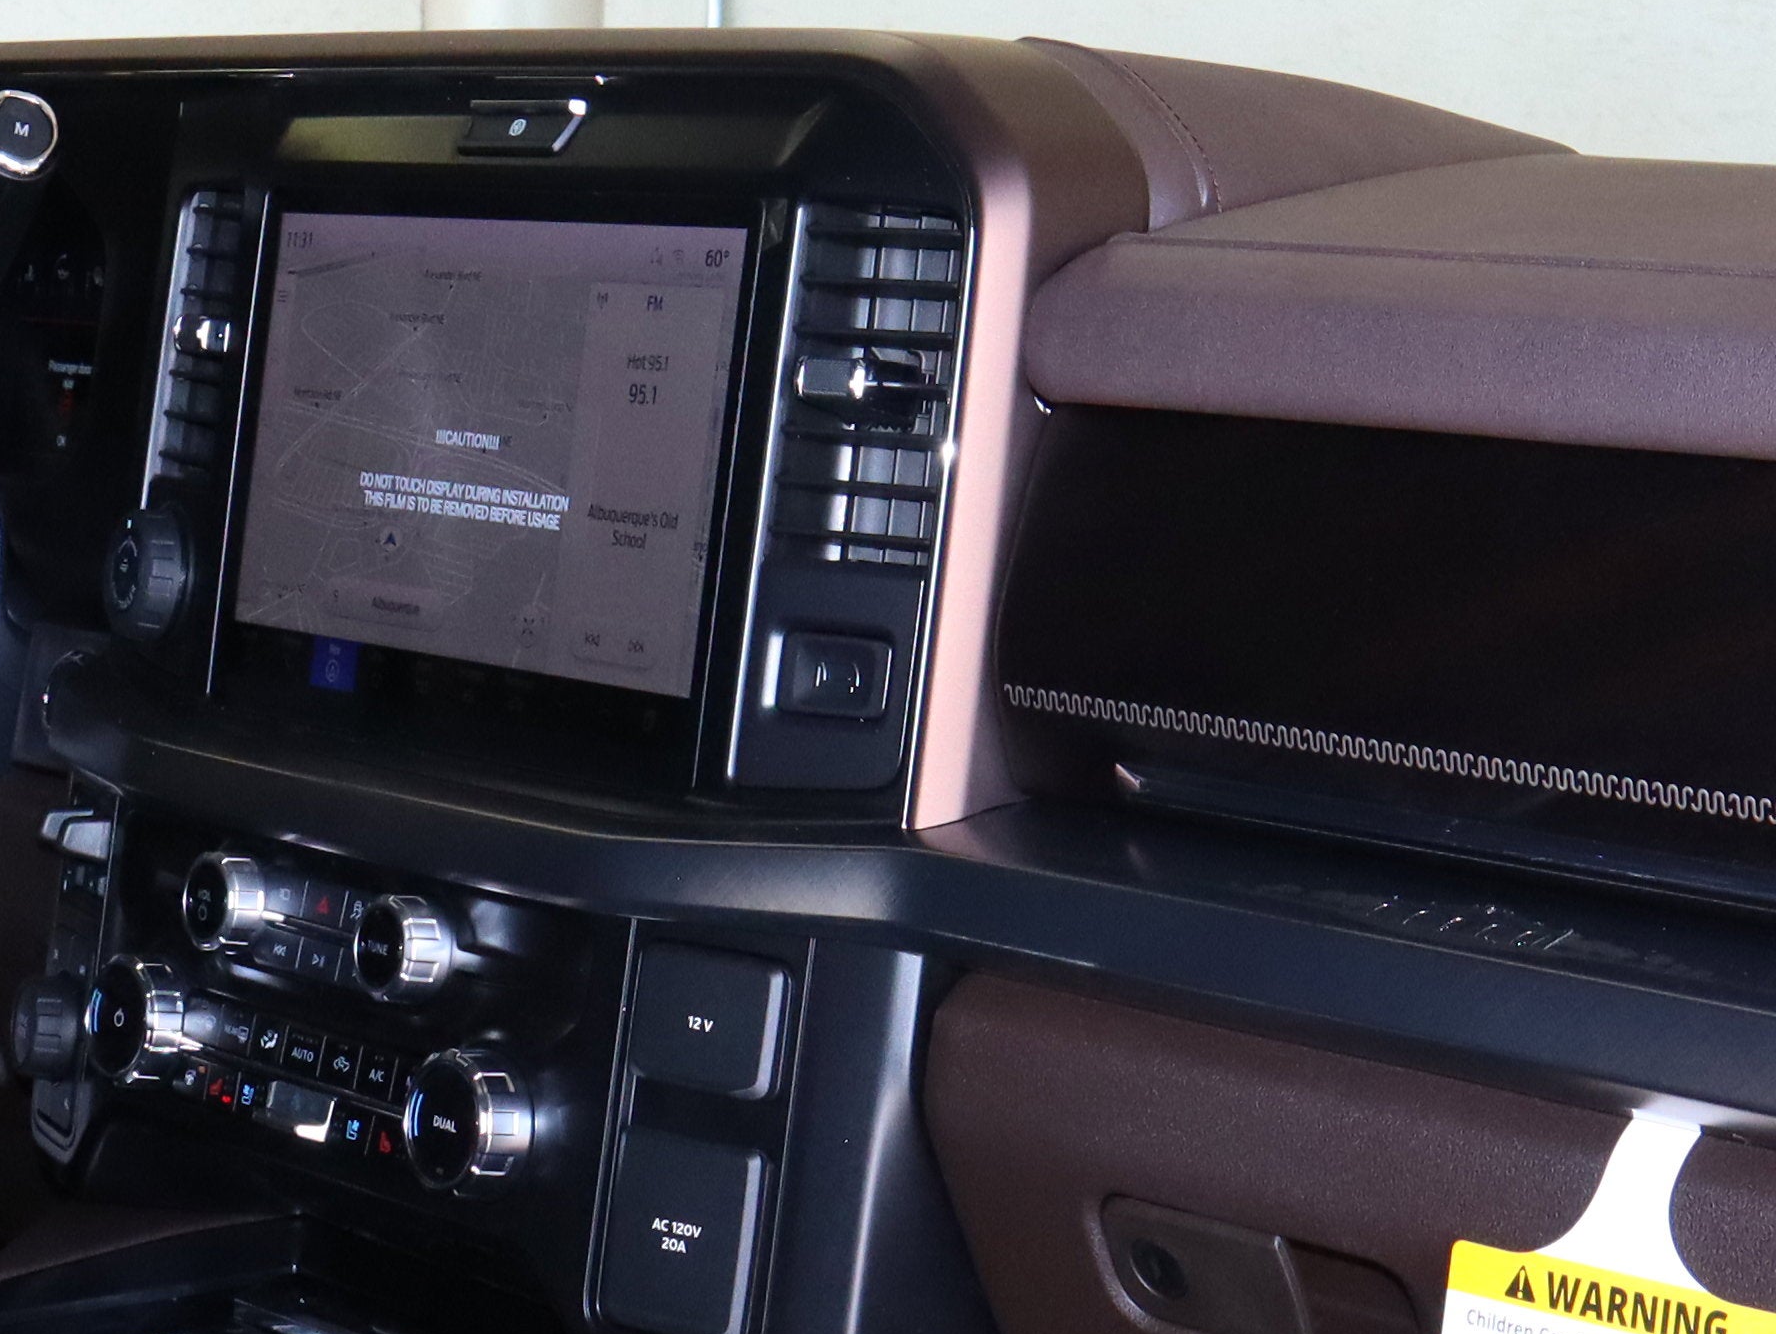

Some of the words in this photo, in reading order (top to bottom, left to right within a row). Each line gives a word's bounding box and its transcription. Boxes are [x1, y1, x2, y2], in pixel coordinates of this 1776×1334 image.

[14, 121, 30, 137] M
[647, 295, 663, 311] FM
[629, 383, 657, 405] 95.1
[360, 471, 374, 487] DO
[374, 474, 394, 488] NOT
[395, 476, 426, 494] TOUCH
[426, 480, 464, 499] DISPLAY
[465, 485, 501, 504] DURING
[501, 489, 569, 512] INSTALLATION
[364, 490, 384, 507] THIS
[384, 493, 406, 509] FILM
[406, 496, 416, 511] IS
[417, 497, 429, 513] TO
[429, 499, 443, 515] BE
[444, 500, 488, 520] REMOVED
[489, 507, 526, 526] BEFORE
[527, 512, 561, 531] USAGE
[612, 530, 647, 549] School
[367, 939, 388, 956] TUNE
[687, 1015, 702, 1030] 12
[291, 1047, 314, 1062] AUTO
[369, 1069, 384, 1082] A/C
[433, 1114, 457, 1133] DUAL
[652, 1217, 670, 1232] AC
[672, 1220, 702, 1239] 120V
[661, 1237, 687, 1254] 20A
